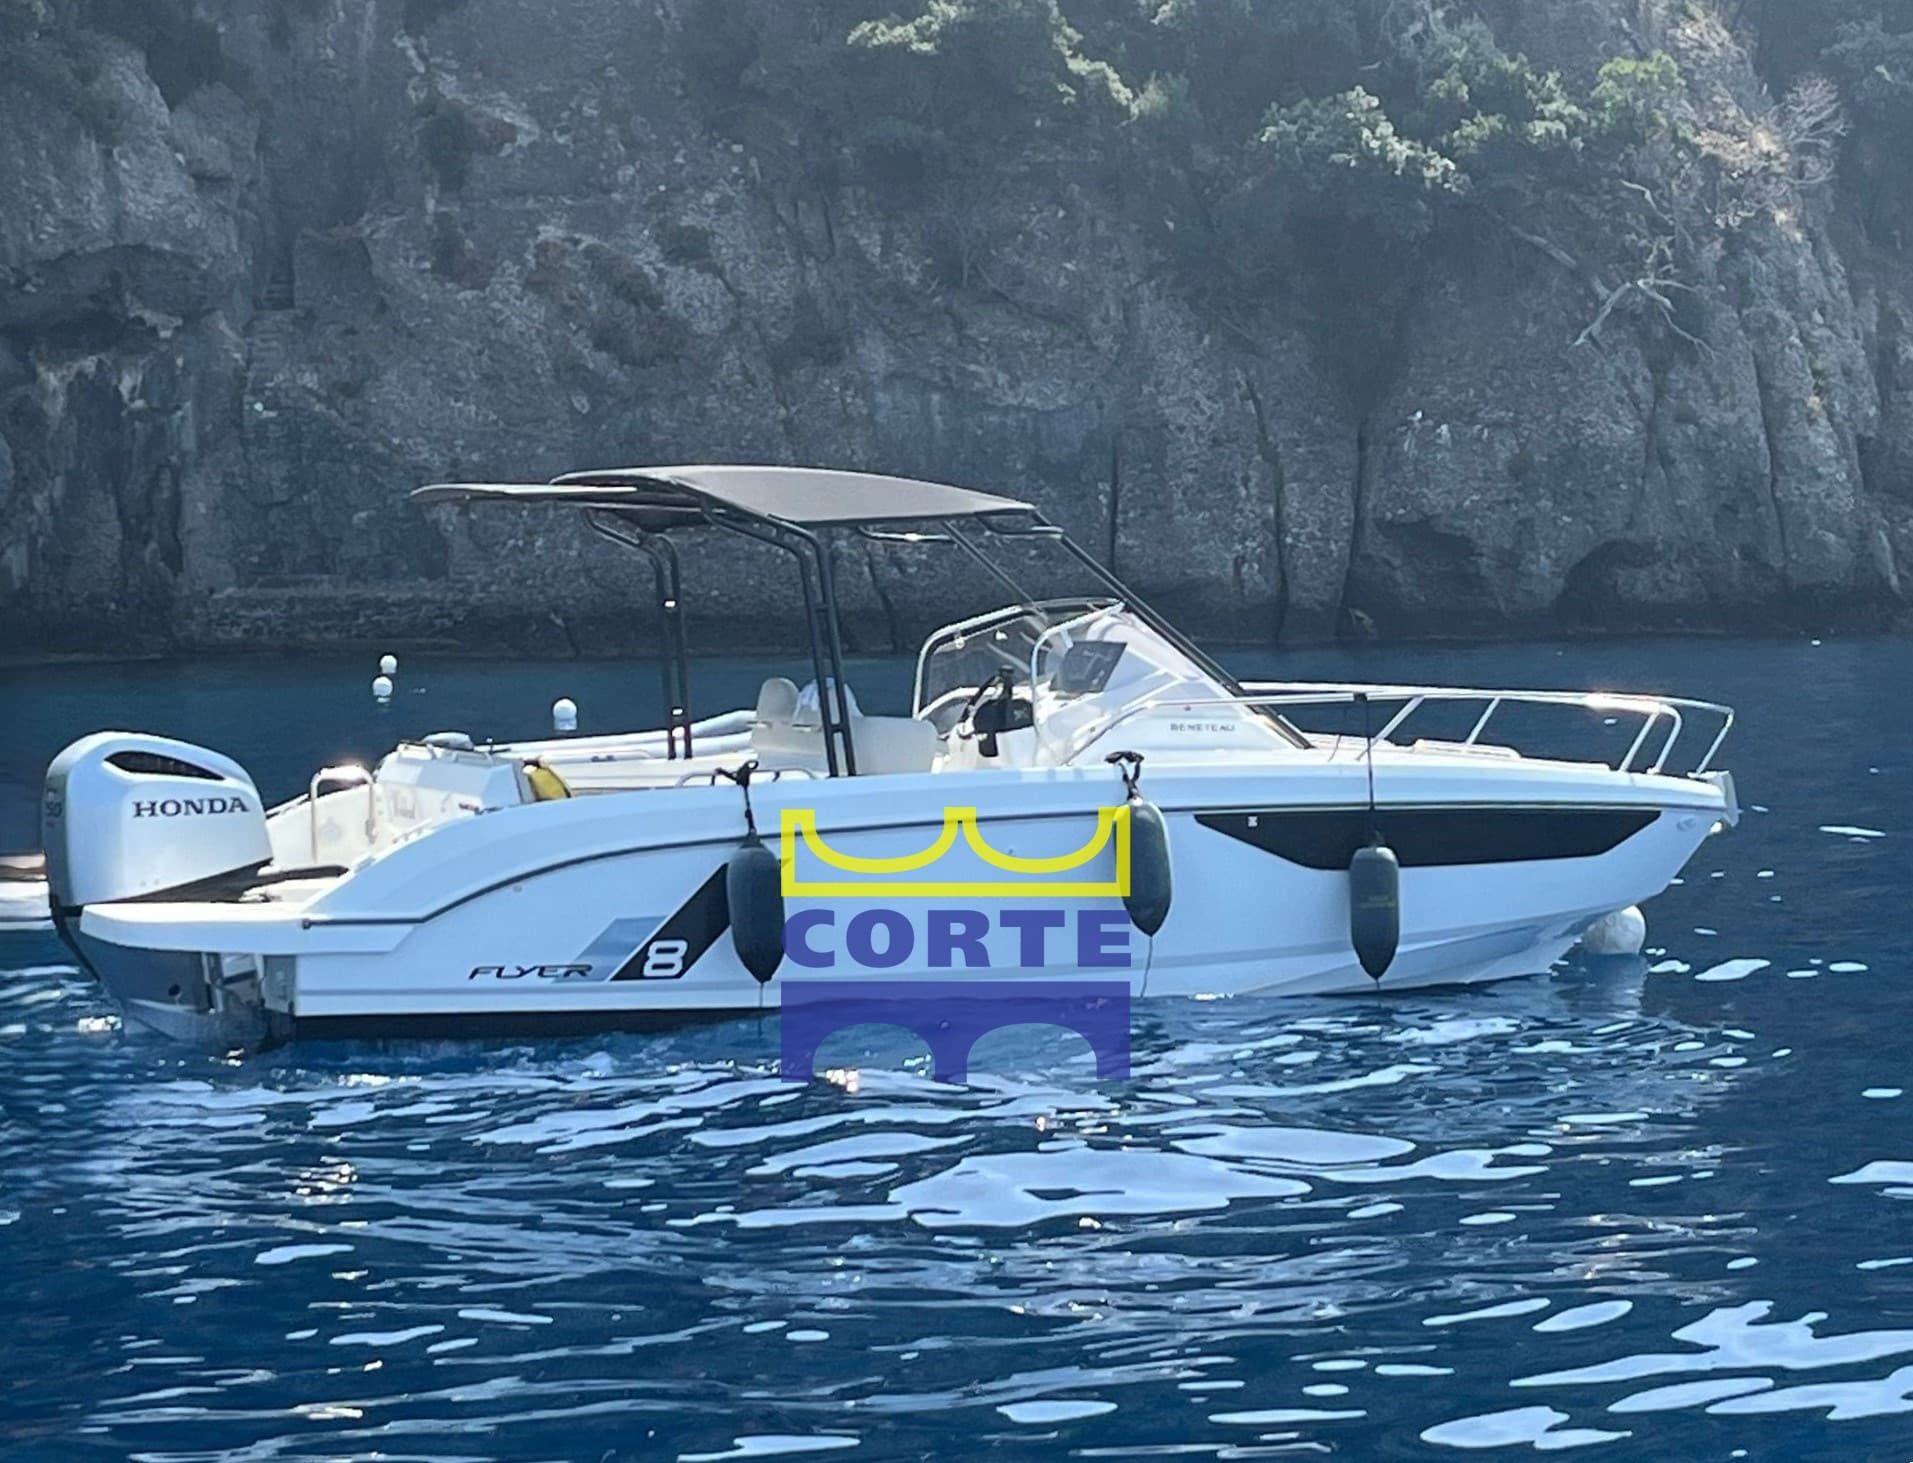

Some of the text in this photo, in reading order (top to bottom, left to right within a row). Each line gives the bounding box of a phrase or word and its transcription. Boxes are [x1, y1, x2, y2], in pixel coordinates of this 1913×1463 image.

[1170, 723, 1236, 733] BENETEAU
[132, 796, 250, 818] HONDA
[468, 939, 688, 980] FLYER 8
